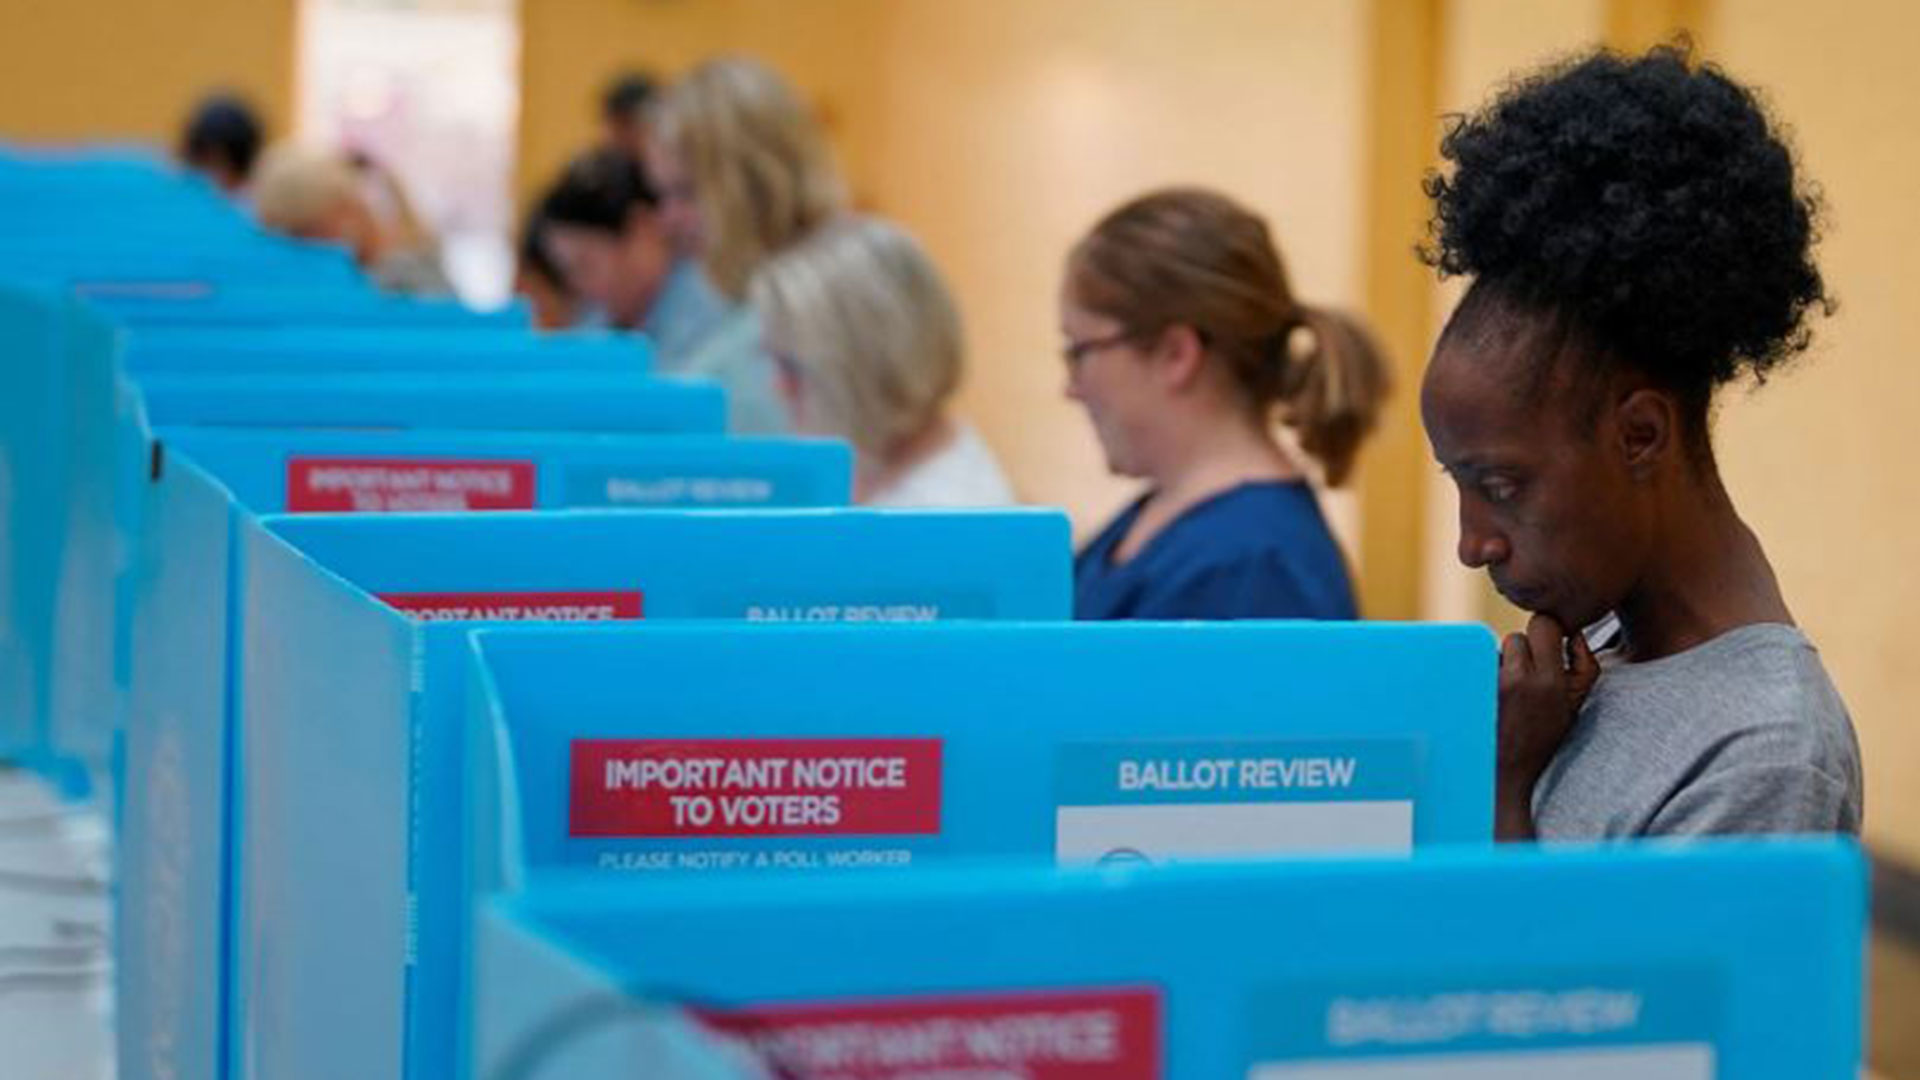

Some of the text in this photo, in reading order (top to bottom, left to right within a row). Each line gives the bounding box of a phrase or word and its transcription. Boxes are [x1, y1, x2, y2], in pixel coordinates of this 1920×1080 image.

[606, 757, 907, 790] IMPORTANT NOTICE
[1118, 758, 1355, 790] BALLOT REVIEW
[670, 795, 841, 826] TO VOTERS
[601, 849, 912, 869] PLEASE NOTIFY A POLL WORKER
